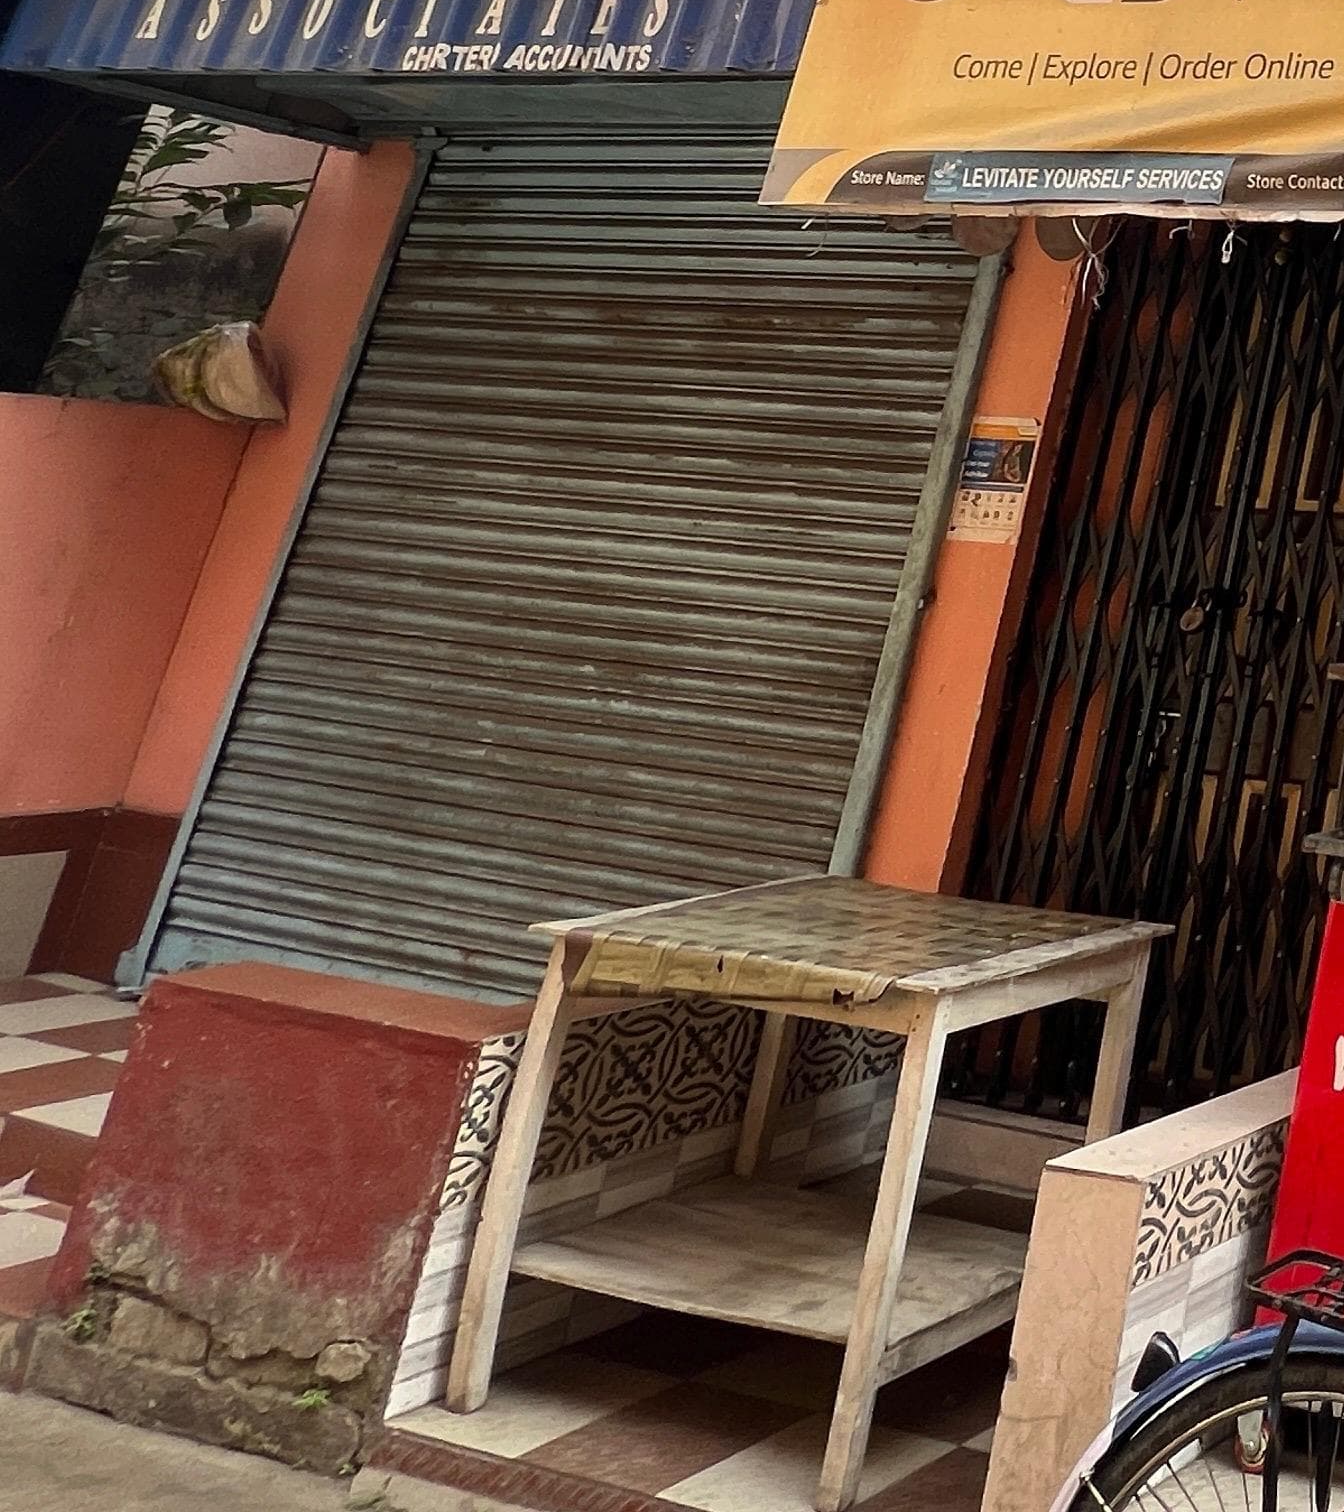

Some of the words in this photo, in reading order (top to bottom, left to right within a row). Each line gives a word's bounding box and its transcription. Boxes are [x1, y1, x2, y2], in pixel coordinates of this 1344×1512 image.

[953, 52, 1022, 82] Come
[1042, 53, 1137, 85] Explore
[1159, 52, 1238, 81] Order
[1244, 52, 1335, 81] Online
[962, 168, 1040, 188] LEVITATE
[1043, 168, 1133, 189] YOURSELF
[1137, 168, 1224, 190] SERVICES
